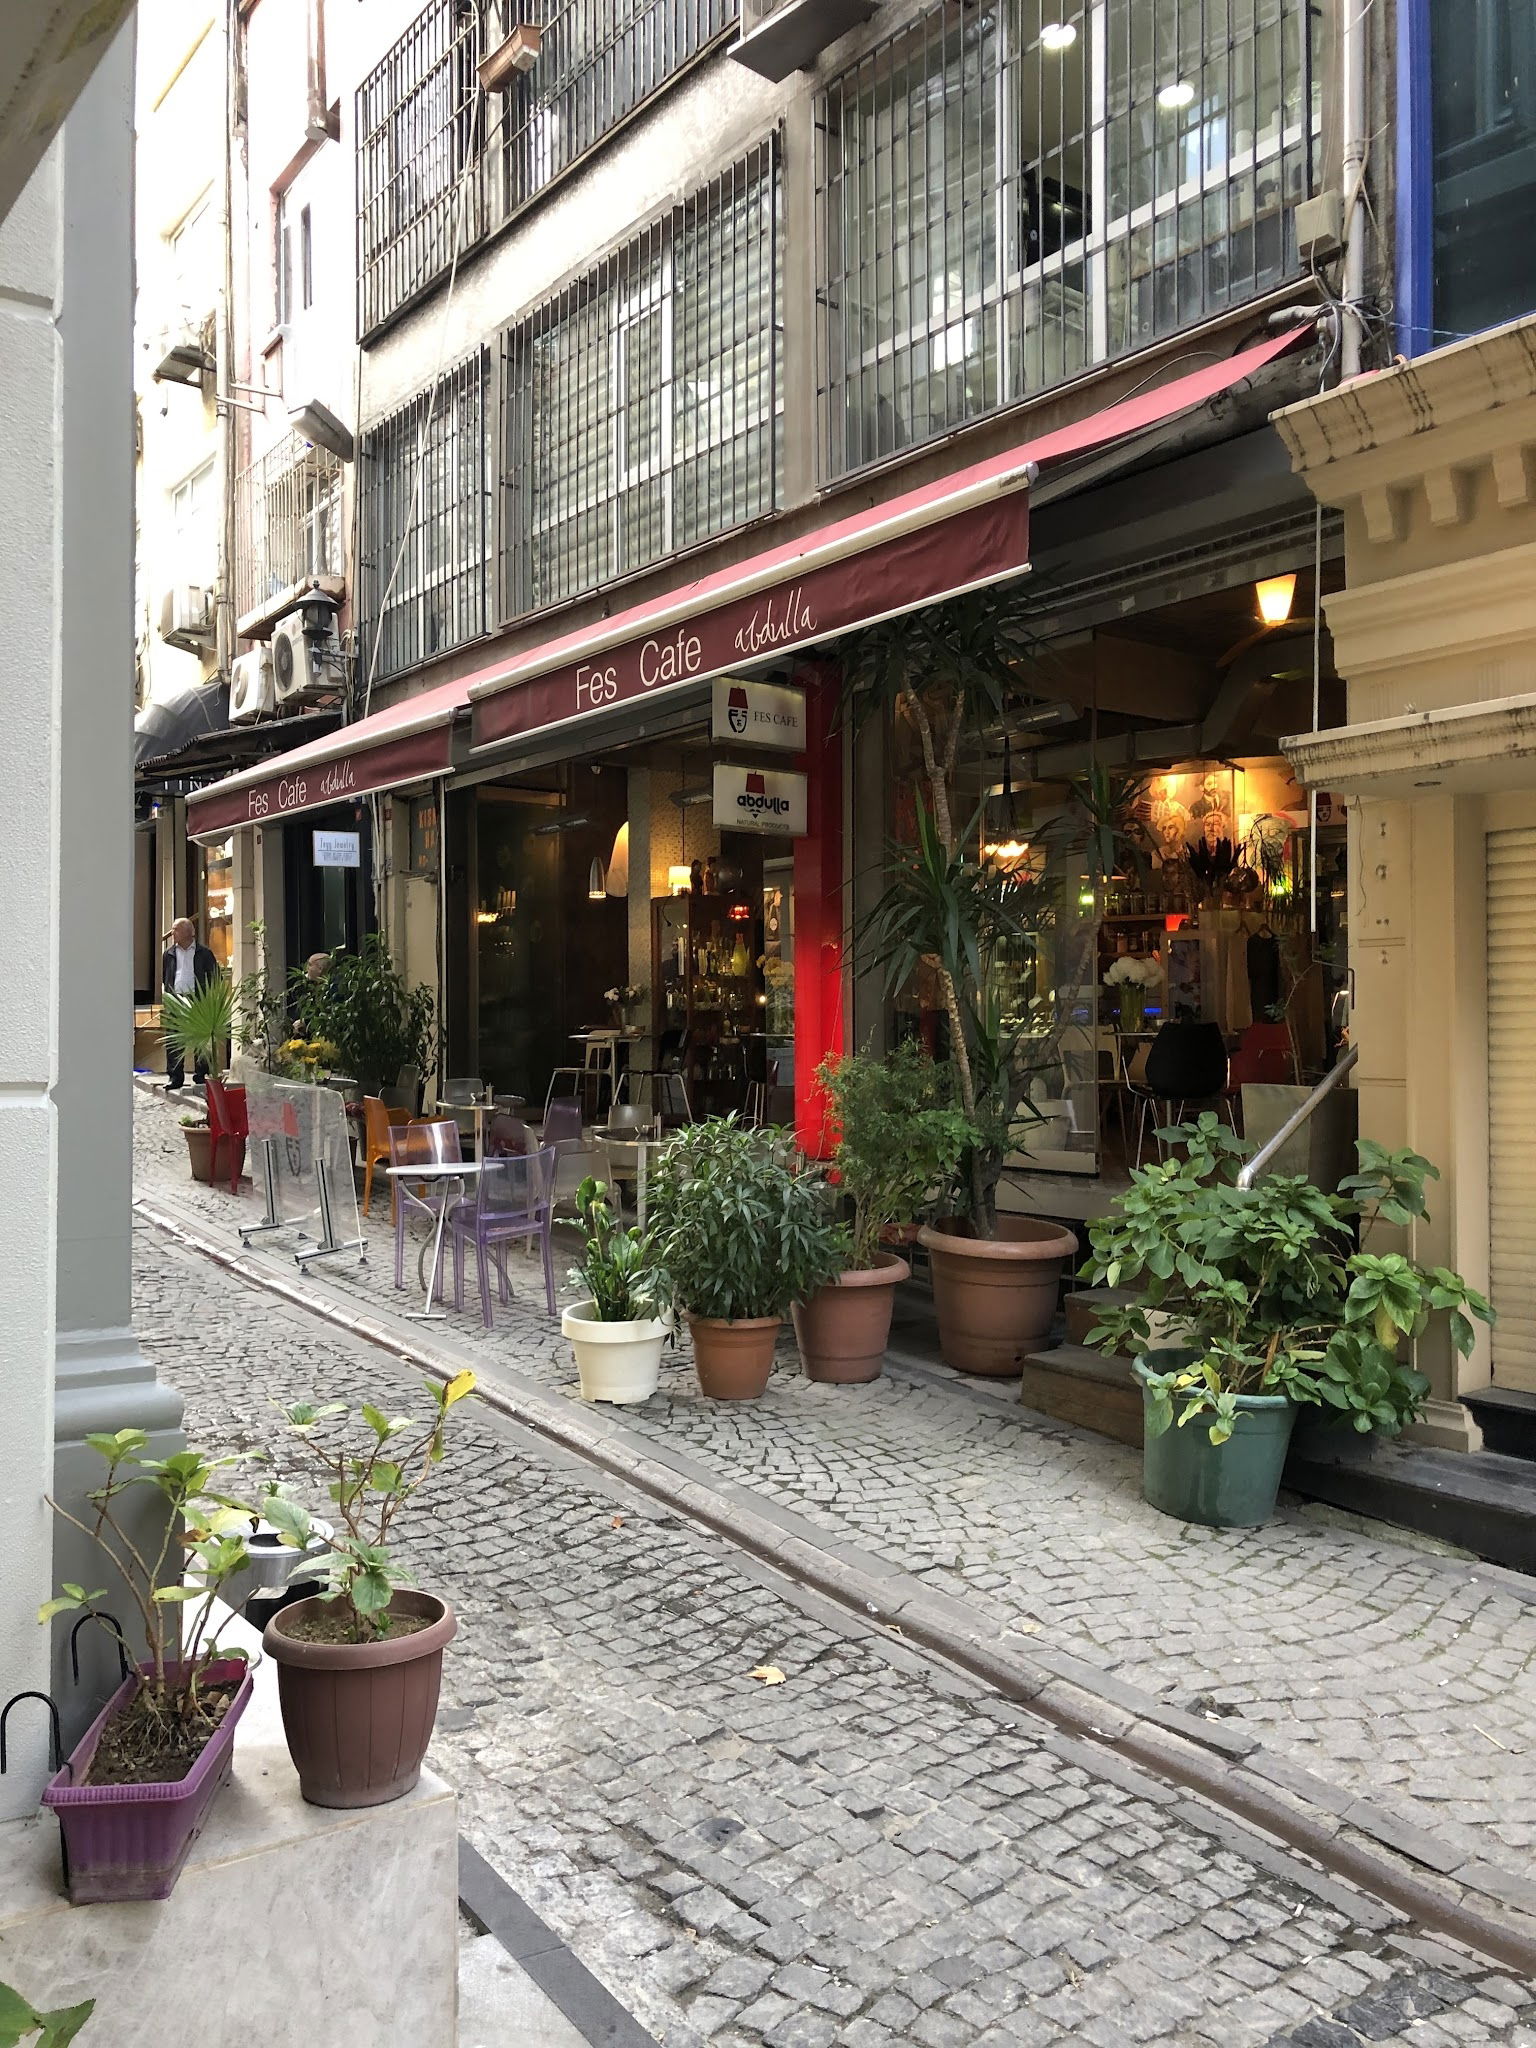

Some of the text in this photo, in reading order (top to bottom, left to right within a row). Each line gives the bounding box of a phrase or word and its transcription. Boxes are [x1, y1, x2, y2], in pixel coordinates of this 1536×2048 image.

[576, 587, 818, 710] Fes Cafe abdulla
[753, 711, 799, 727] FES CAFE
[248, 759, 357, 818] Fes Cafe abdulla
[737, 794, 790, 815] abdulla
